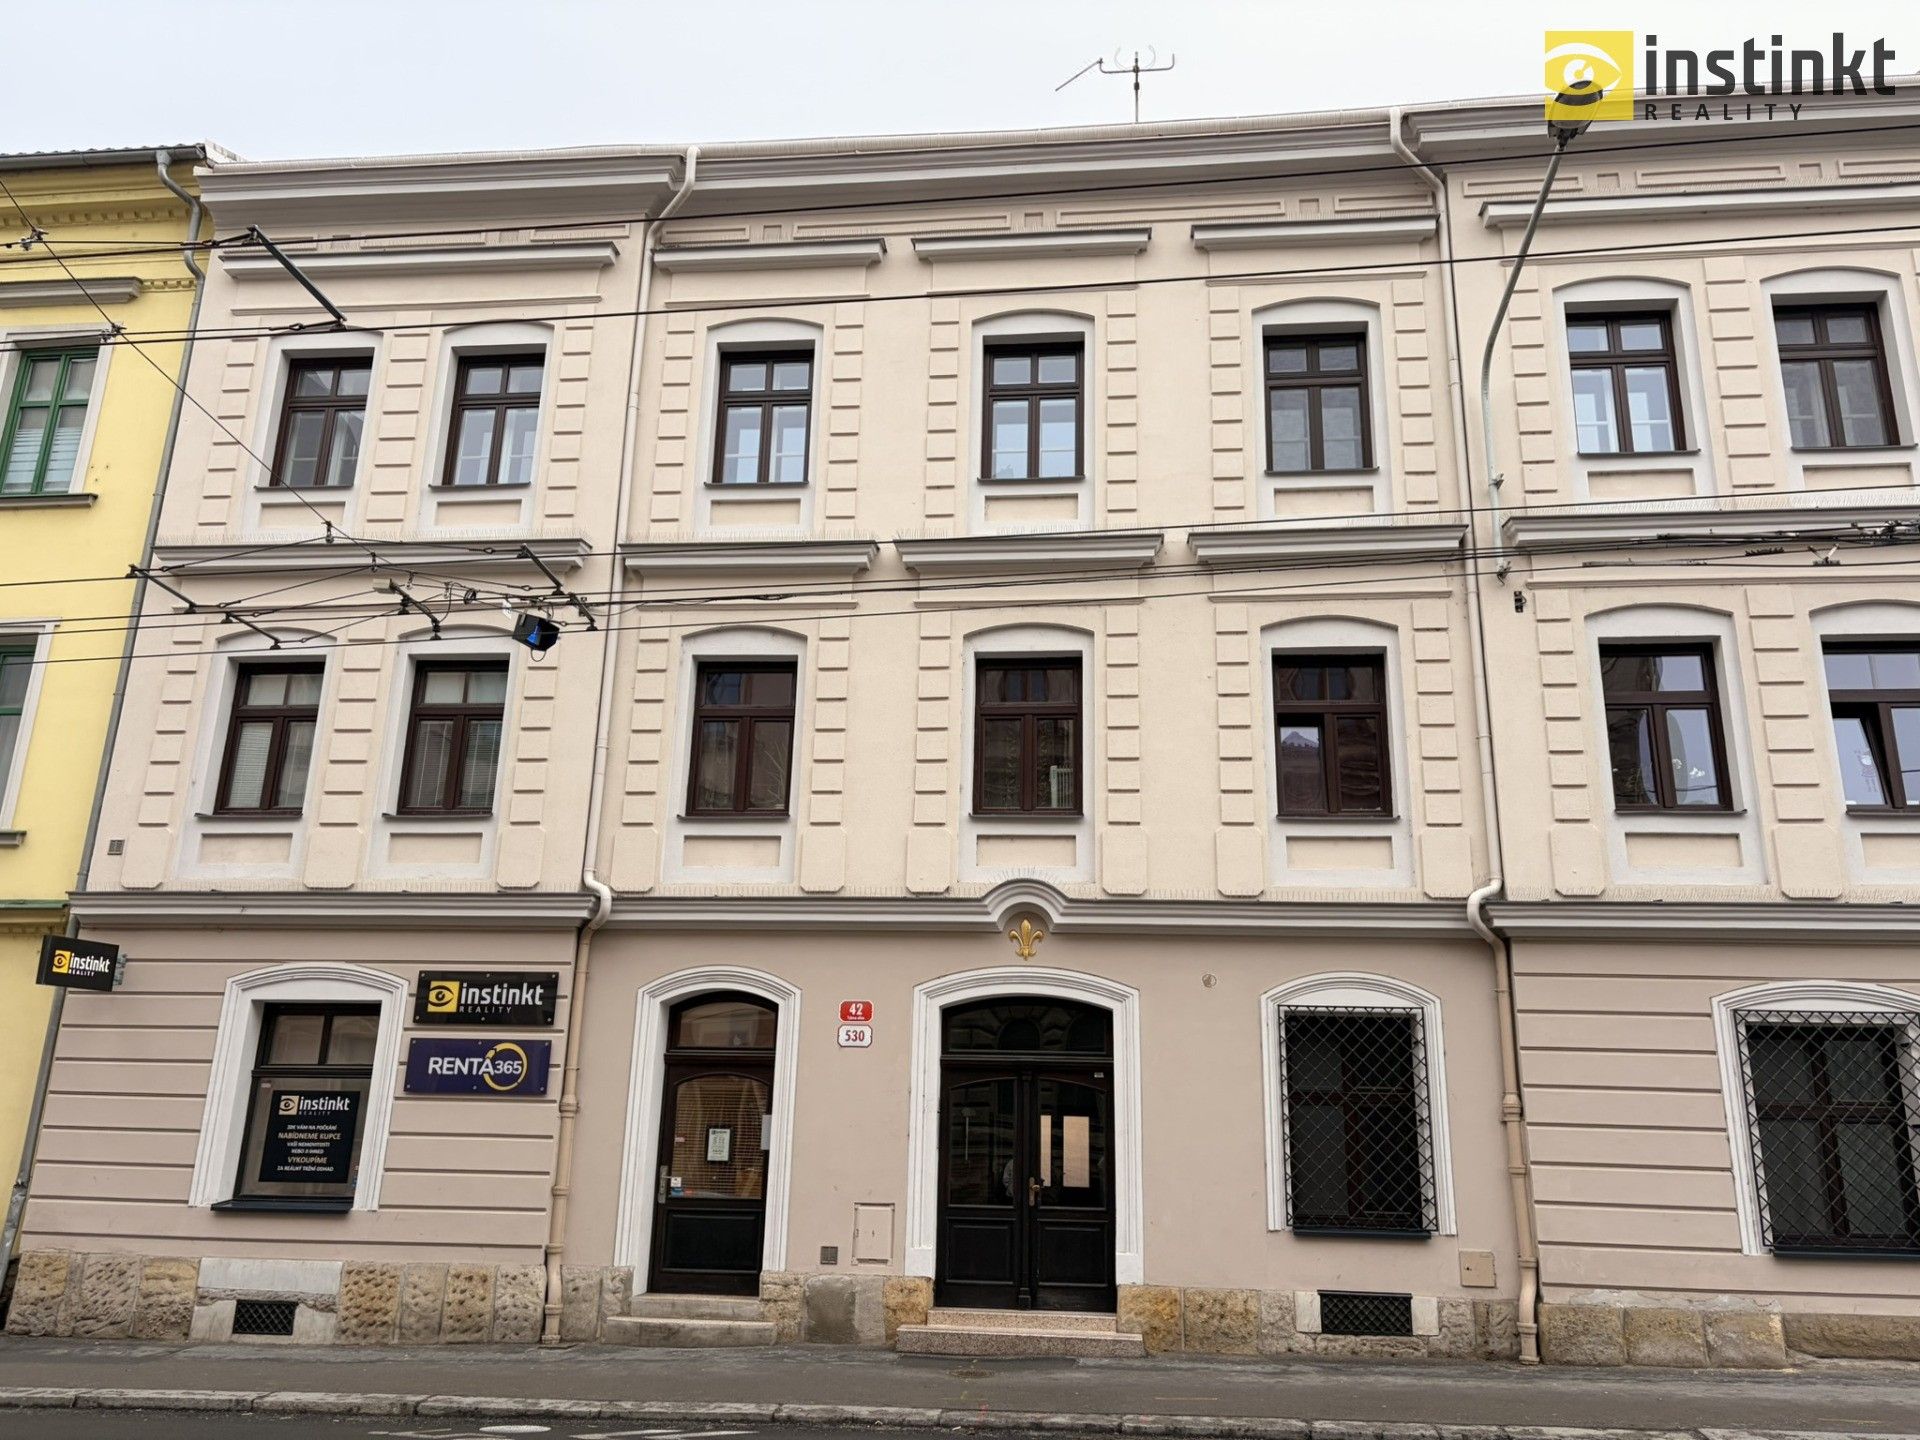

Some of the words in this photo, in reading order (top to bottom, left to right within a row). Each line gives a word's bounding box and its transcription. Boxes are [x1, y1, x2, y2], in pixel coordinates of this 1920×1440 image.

[69, 952, 111, 973] instinkt
[68, 968, 95, 977] REALITY
[460, 982, 544, 1006] instinkt
[459, 1006, 512, 1014] REALITY
[849, 1003, 863, 1015] 42
[845, 1030, 865, 1042] 530
[428, 1057, 523, 1076] RENTA365
[299, 1096, 350, 1111] instinkt
[278, 1131, 319, 1139] NABÍDNEME
[287, 1155, 328, 1164] VYKOUPÍME
